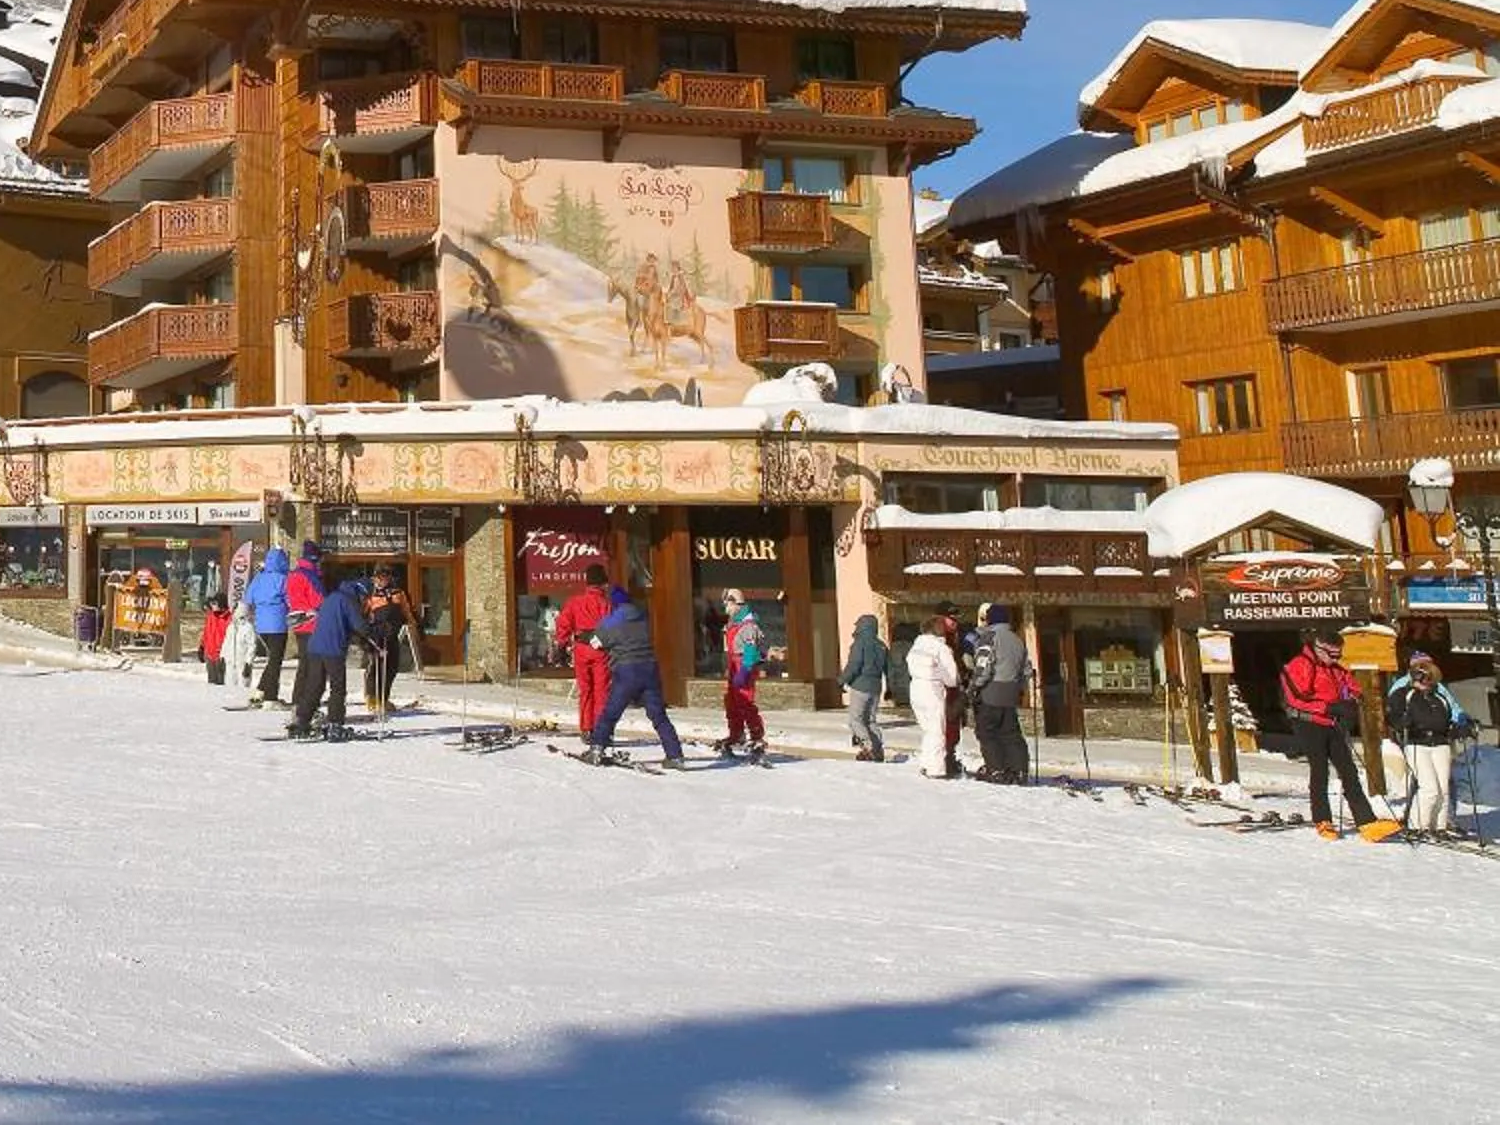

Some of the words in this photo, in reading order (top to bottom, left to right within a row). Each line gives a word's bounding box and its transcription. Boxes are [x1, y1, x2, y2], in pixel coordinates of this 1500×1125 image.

[922, 445, 1039, 471] Courchevel
[1046, 448, 1122, 472] Agence
[91, 508, 145, 521] LOCATION
[149, 508, 162, 521] DE
[166, 508, 190, 521] SKIS
[517, 527, 600, 566] Frisson
[695, 537, 777, 561] SUGAR
[531, 572, 588, 581] LINGERI
[1243, 564, 1339, 588] Supreme
[1229, 591, 1293, 605] MEETING
[1299, 590, 1342, 604] POINT
[1223, 606, 1351, 620] RASSEMBLEMENT
